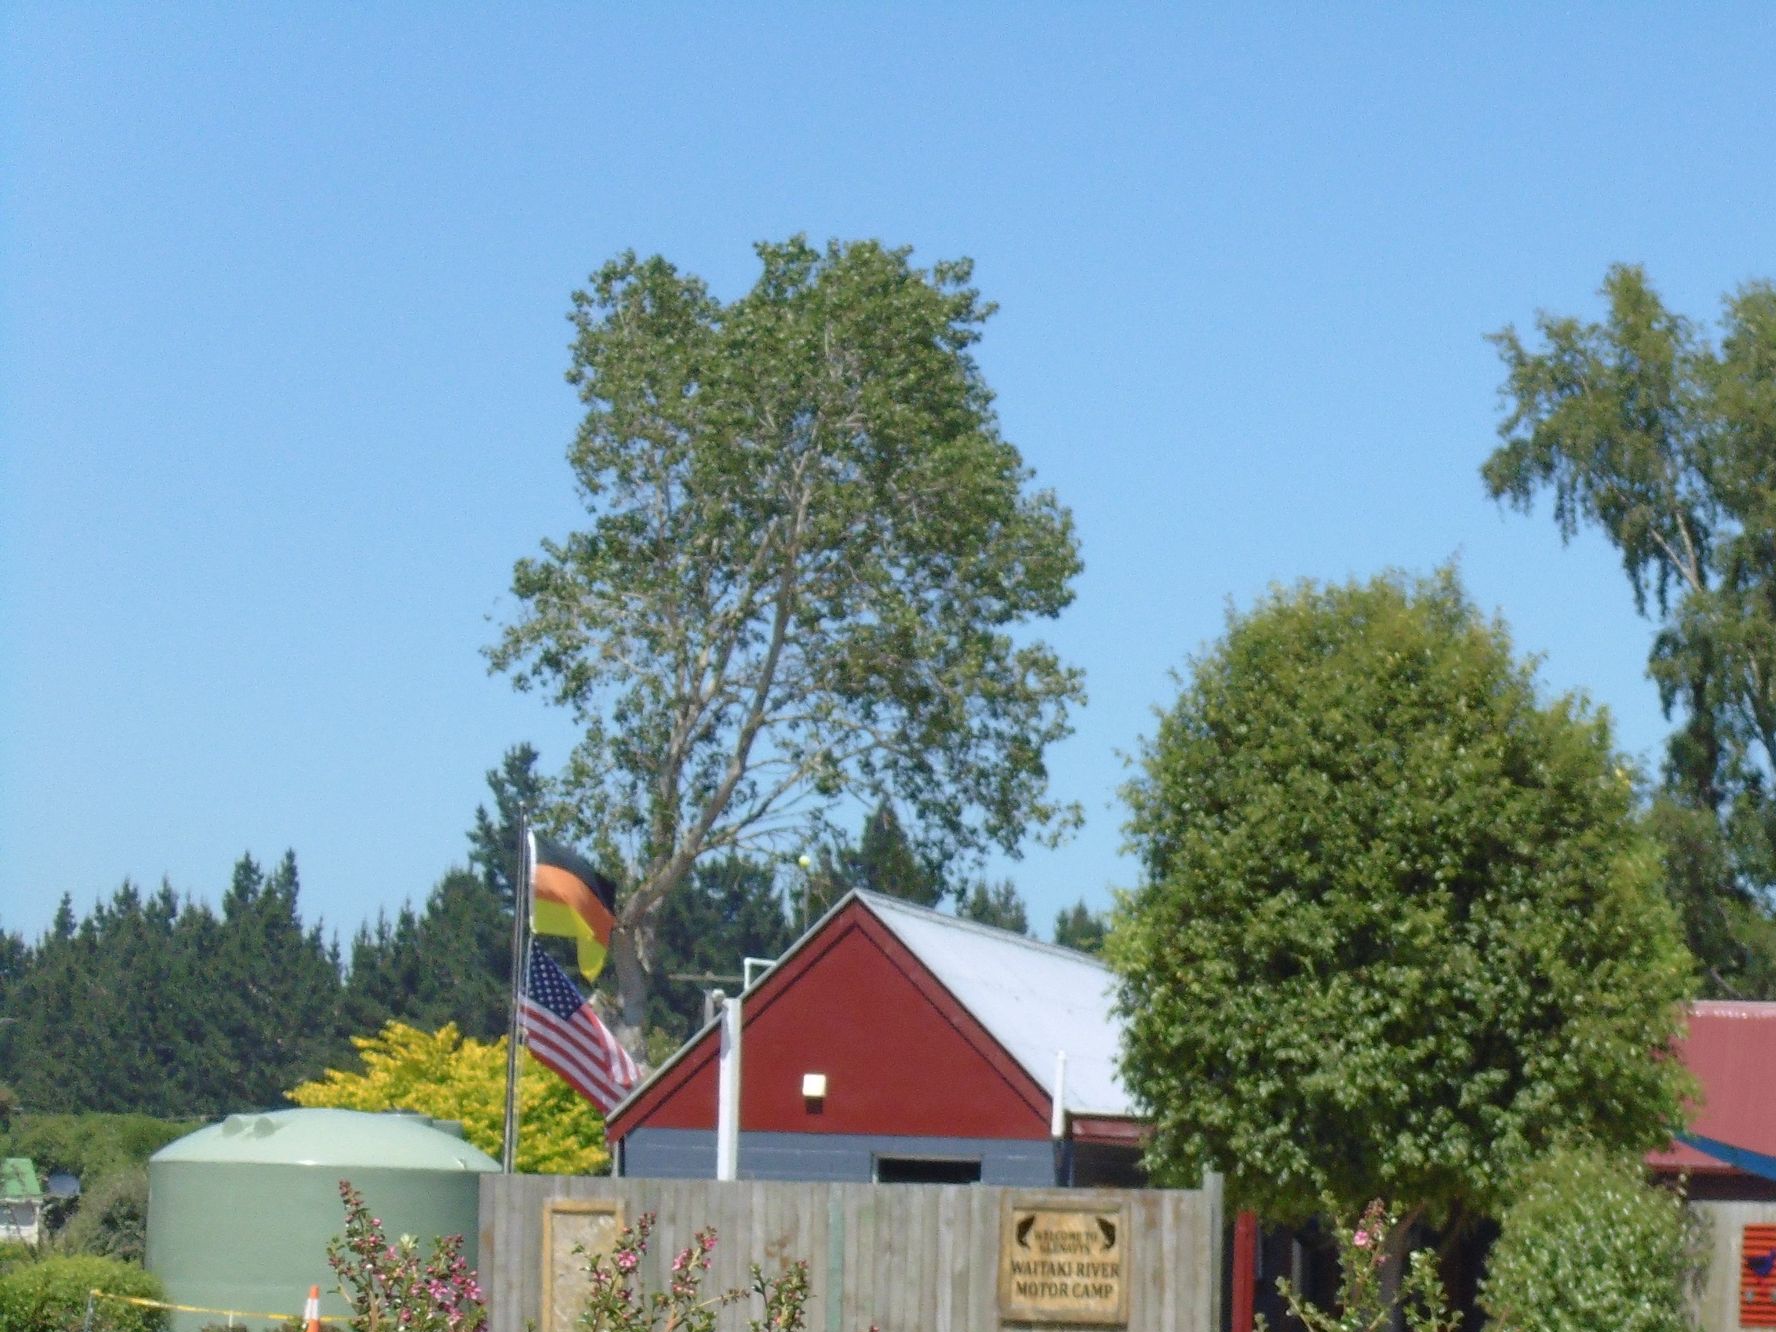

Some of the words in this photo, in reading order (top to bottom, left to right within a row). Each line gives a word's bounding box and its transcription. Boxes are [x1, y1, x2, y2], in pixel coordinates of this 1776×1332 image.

[1010, 1260, 1072, 1277] WAITAKI
[1076, 1262, 1119, 1278] RIVER
[1016, 1281, 1068, 1297] MOTOR
[1071, 1283, 1113, 1299] CAMP
